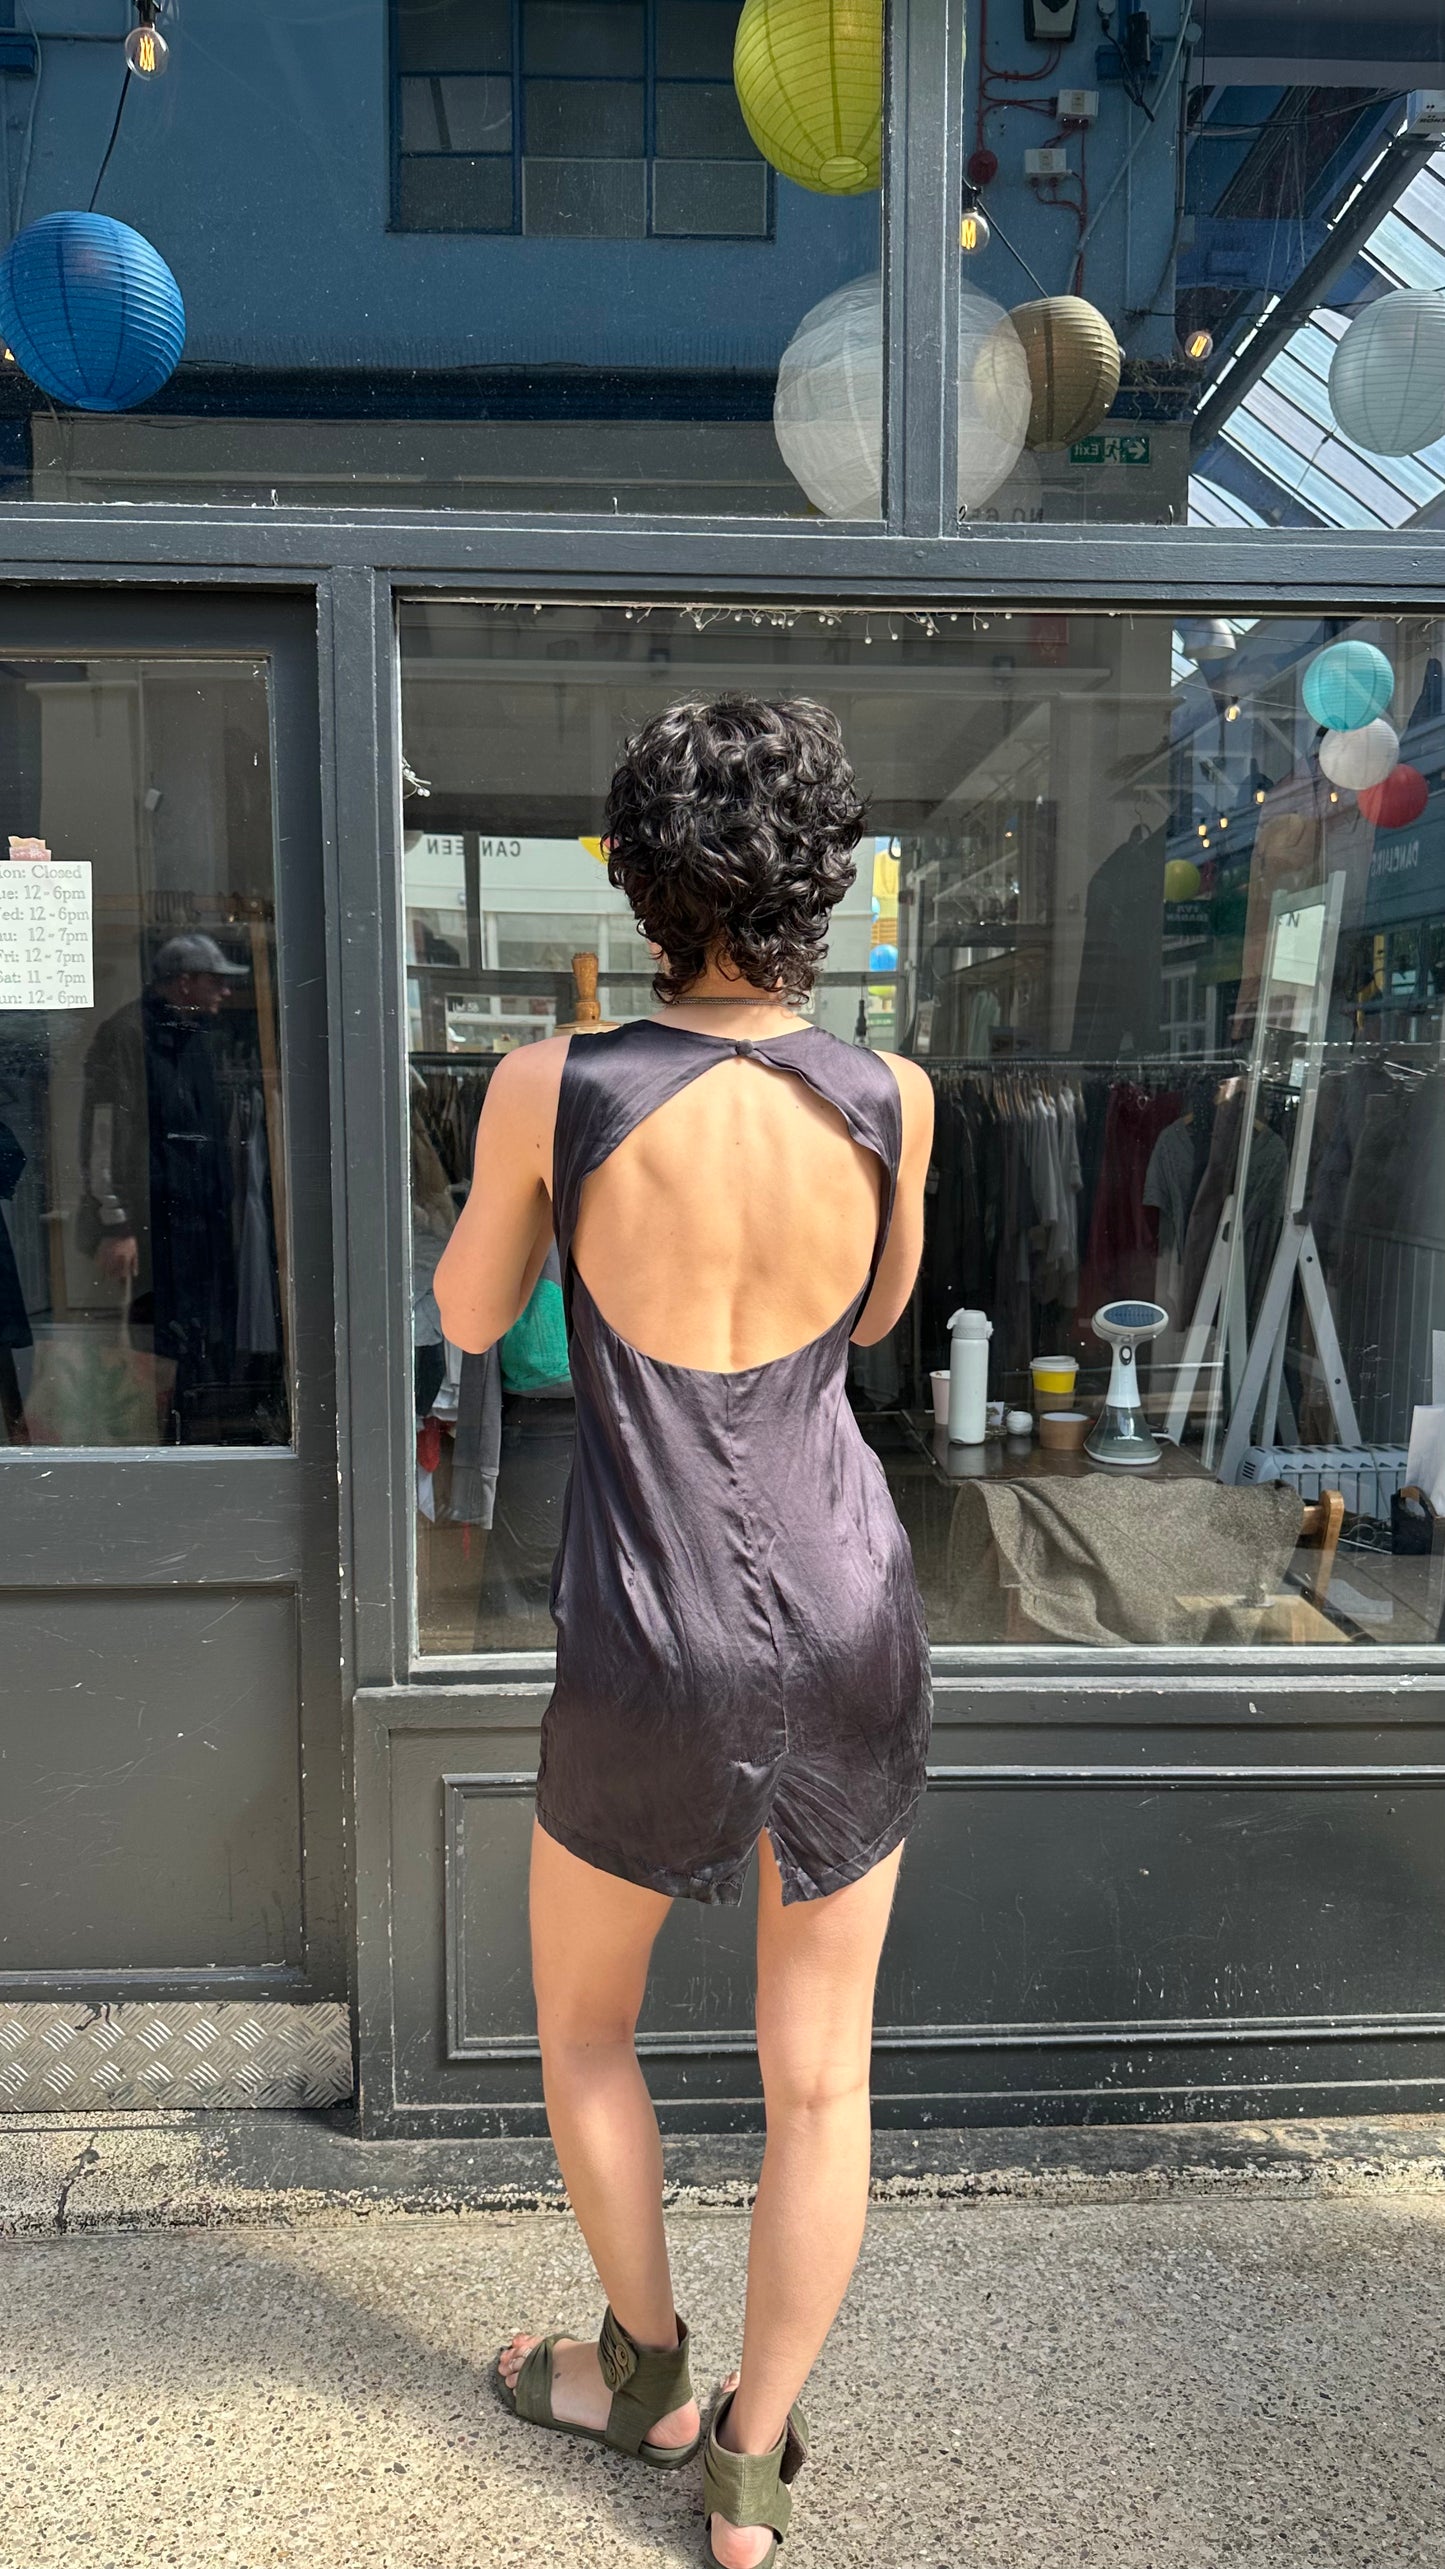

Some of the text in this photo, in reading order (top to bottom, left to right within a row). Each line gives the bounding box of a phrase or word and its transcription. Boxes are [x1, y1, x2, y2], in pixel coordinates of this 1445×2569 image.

[0, 864, 82, 879] on: Closed
[0, 907, 24, 921] ed:
